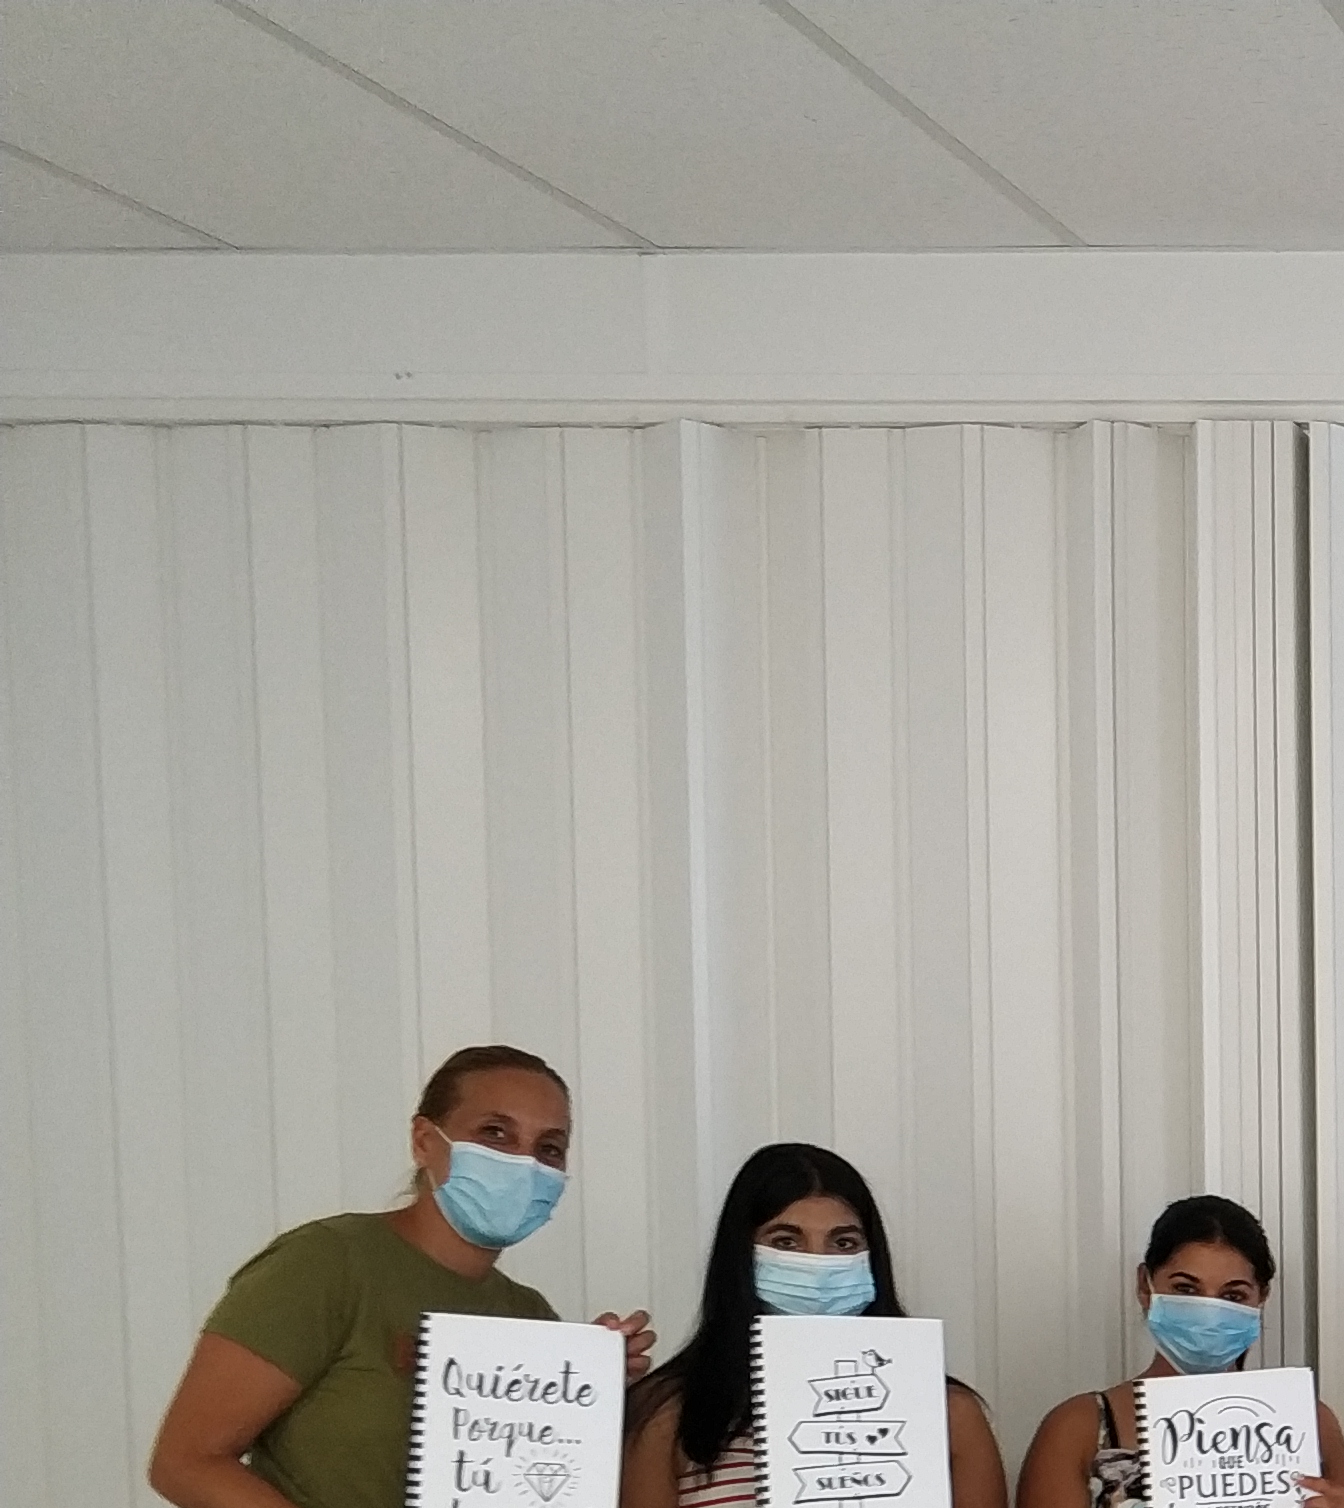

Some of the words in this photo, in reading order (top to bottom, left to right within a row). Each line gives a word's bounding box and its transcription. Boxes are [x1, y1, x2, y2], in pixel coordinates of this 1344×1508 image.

[442, 1357, 597, 1407] Quiérete
[823, 1385, 880, 1403] SIGUE
[1153, 1410, 1306, 1465] Piensa
[451, 1450, 500, 1494] tú
[816, 1471, 886, 1491] SUEÑOS
[1178, 1470, 1292, 1499] PUEDES
